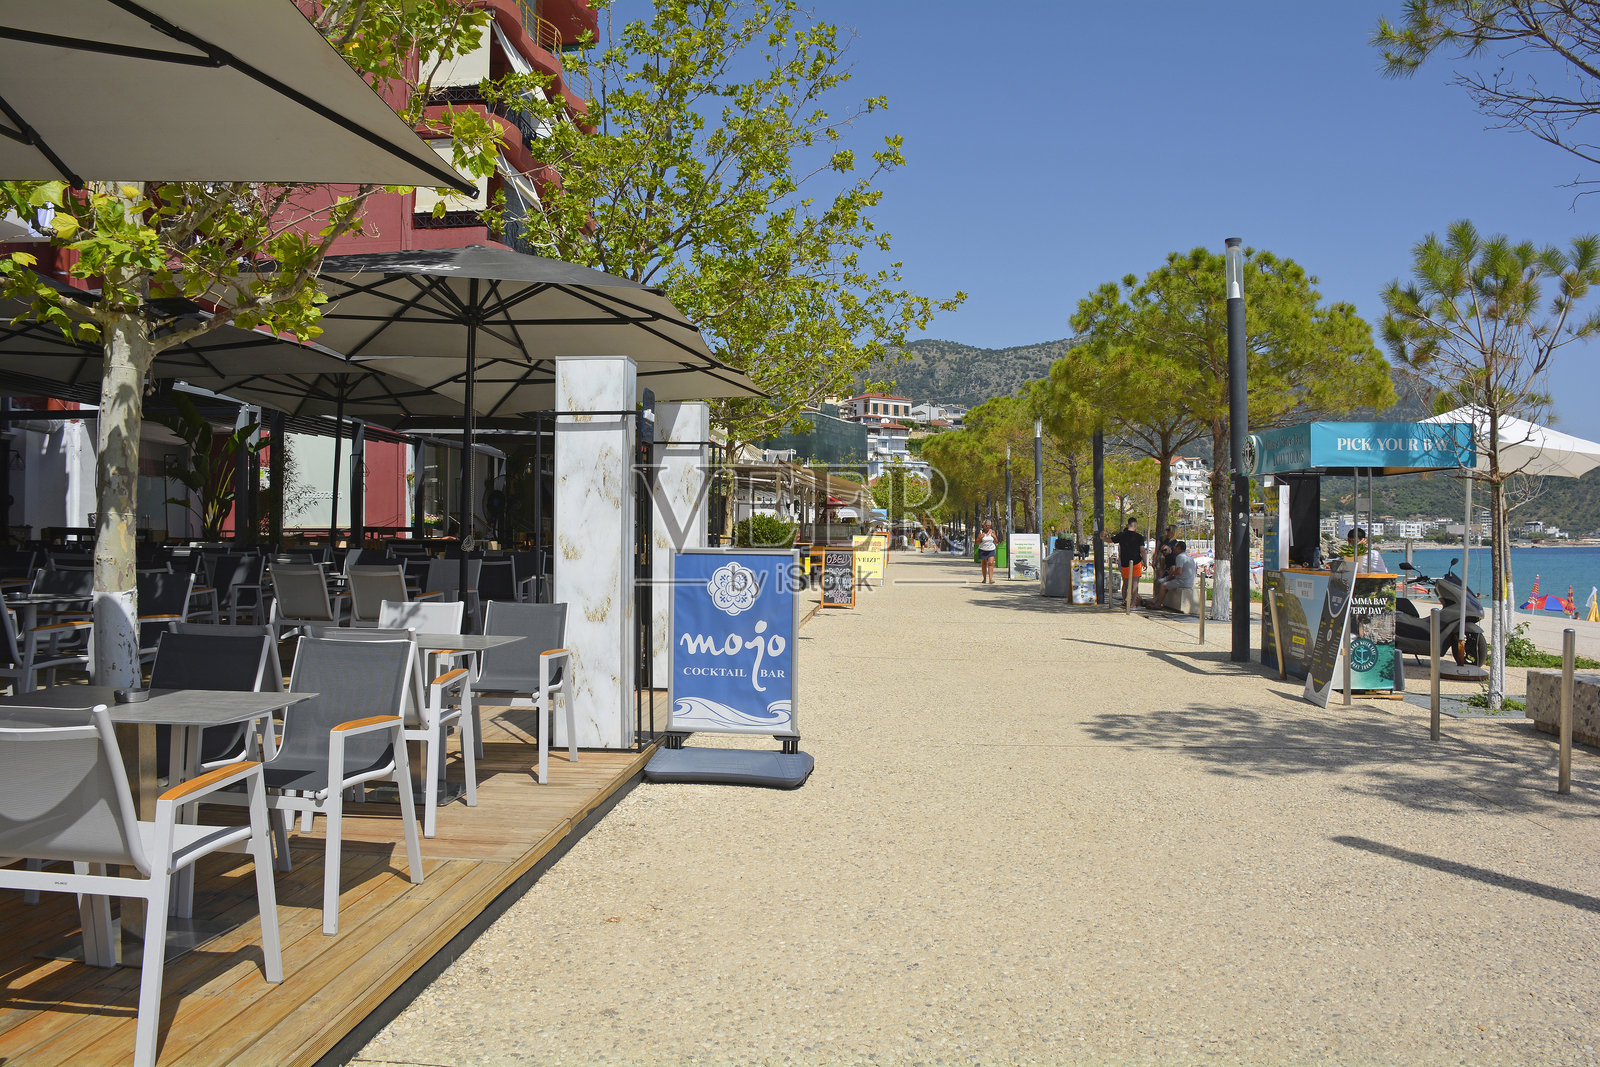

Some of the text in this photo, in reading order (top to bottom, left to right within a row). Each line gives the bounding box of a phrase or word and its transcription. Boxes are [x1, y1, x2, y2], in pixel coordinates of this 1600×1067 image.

[1337, 437, 1448, 451] PICK YOUR BAY
[1350, 597, 1373, 605] AMMA
[1374, 597, 1388, 605] BAY
[1368, 606, 1384, 614] DAY
[679, 620, 786, 692] mojo
[683, 666, 786, 678] COCKTAIL BAR
